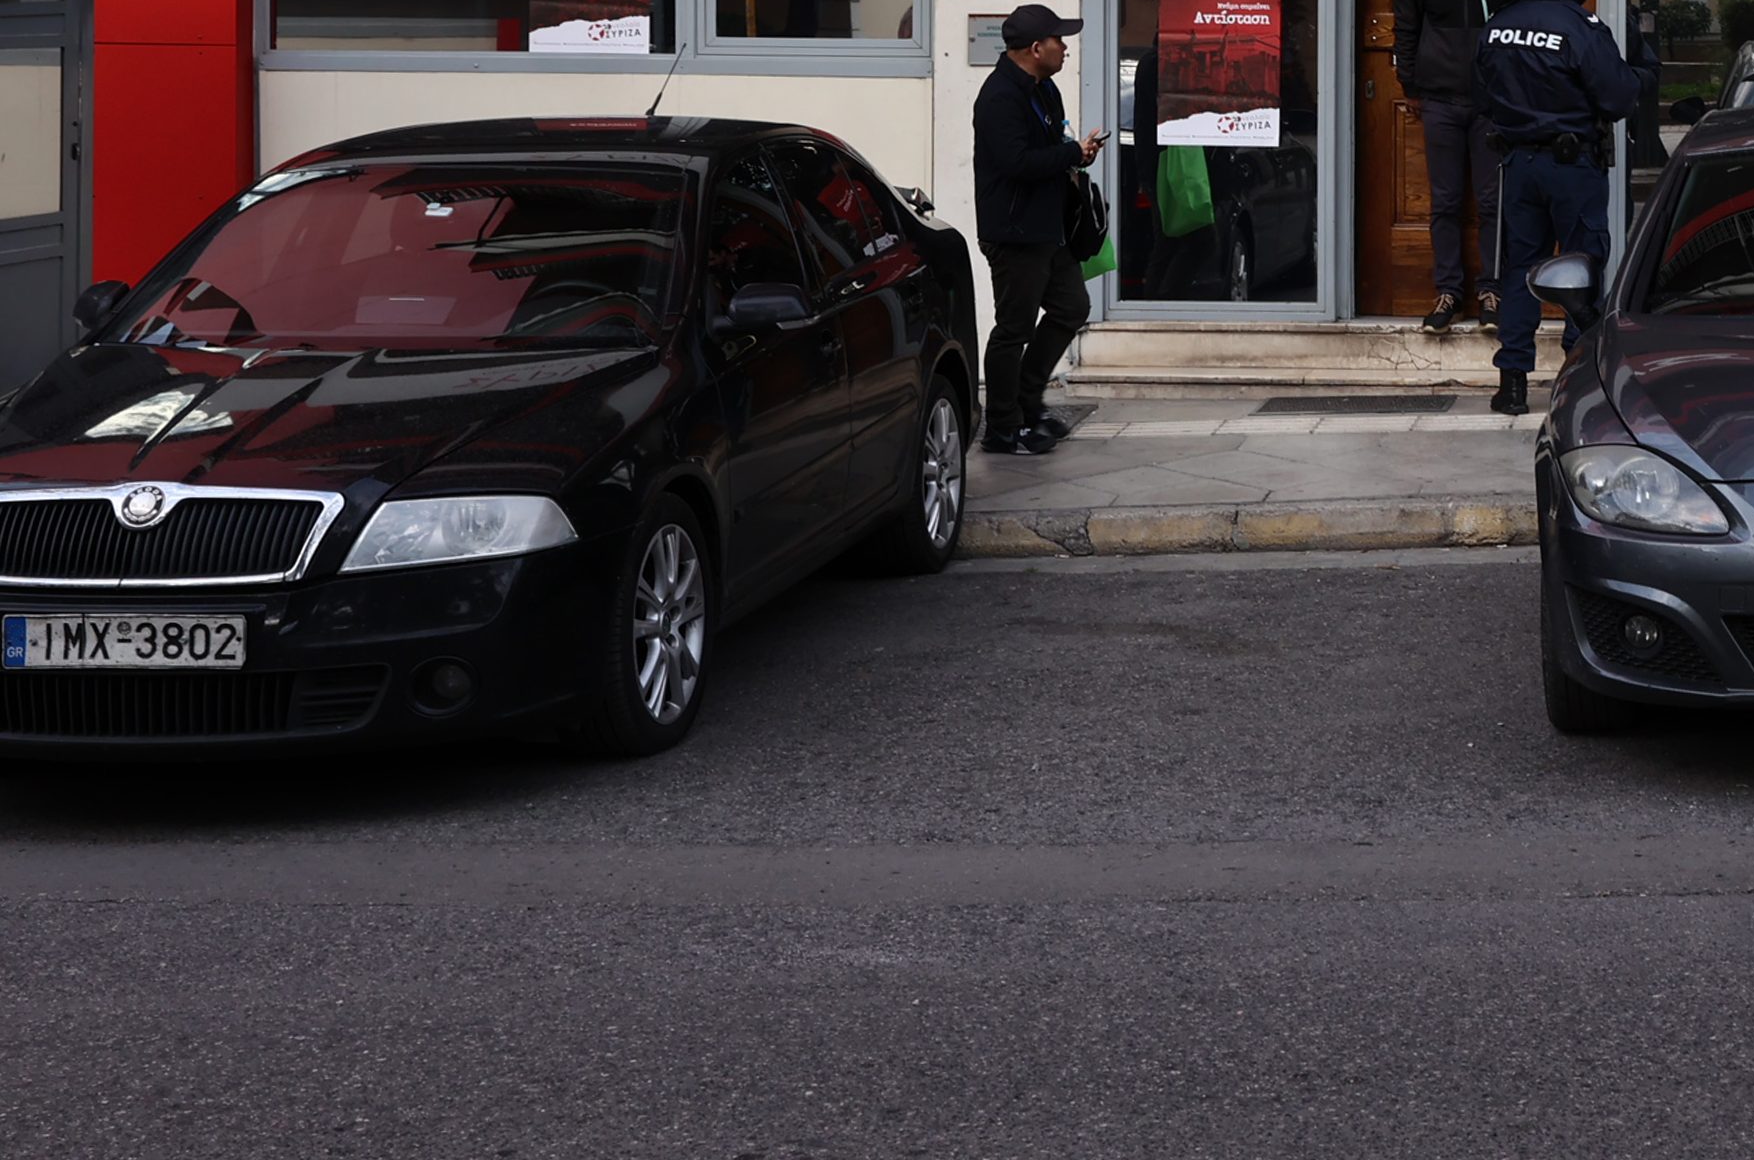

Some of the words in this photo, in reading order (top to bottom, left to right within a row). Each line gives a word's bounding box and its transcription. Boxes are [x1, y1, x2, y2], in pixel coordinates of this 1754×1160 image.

[1193, 10, 1271, 25] Αντίσταση
[1488, 29, 1563, 51] POLICE
[6, 647, 24, 659] GR
